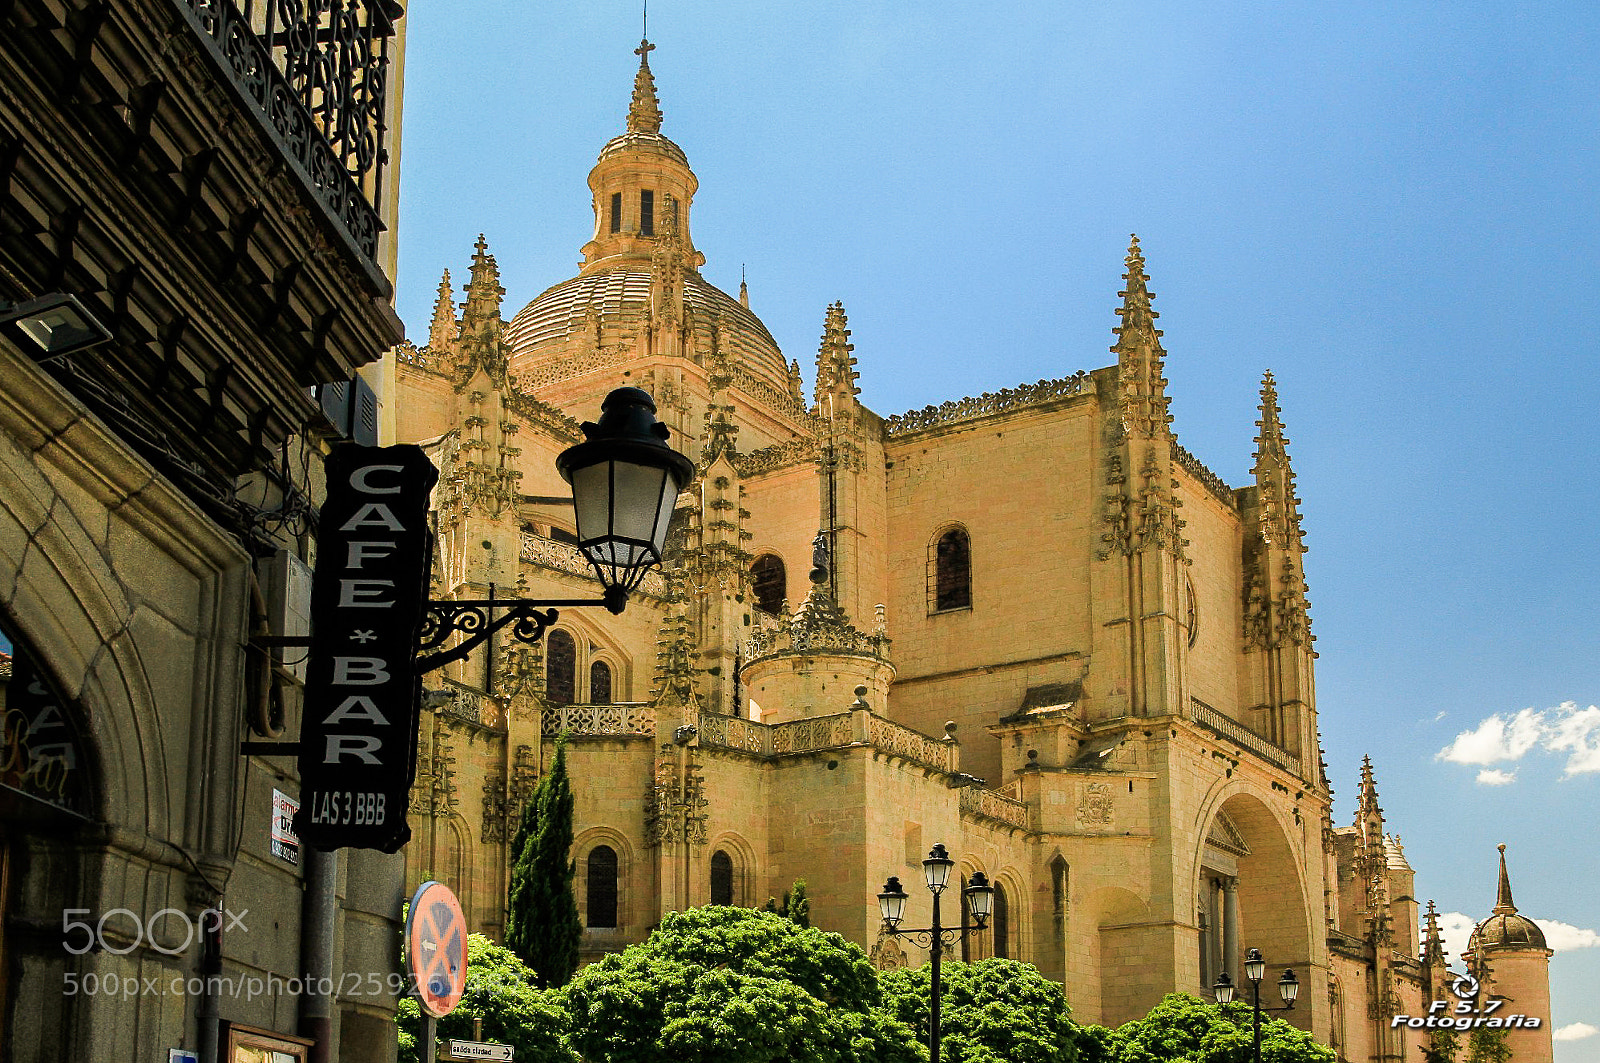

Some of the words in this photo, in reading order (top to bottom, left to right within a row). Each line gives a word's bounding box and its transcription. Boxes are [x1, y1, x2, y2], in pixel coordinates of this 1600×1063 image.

[338, 464, 407, 608] CAFE
[321, 656, 391, 765] BAR
[311, 791, 340, 825] LAS
[342, 791, 352, 826] 3
[355, 793, 386, 826] BBB
